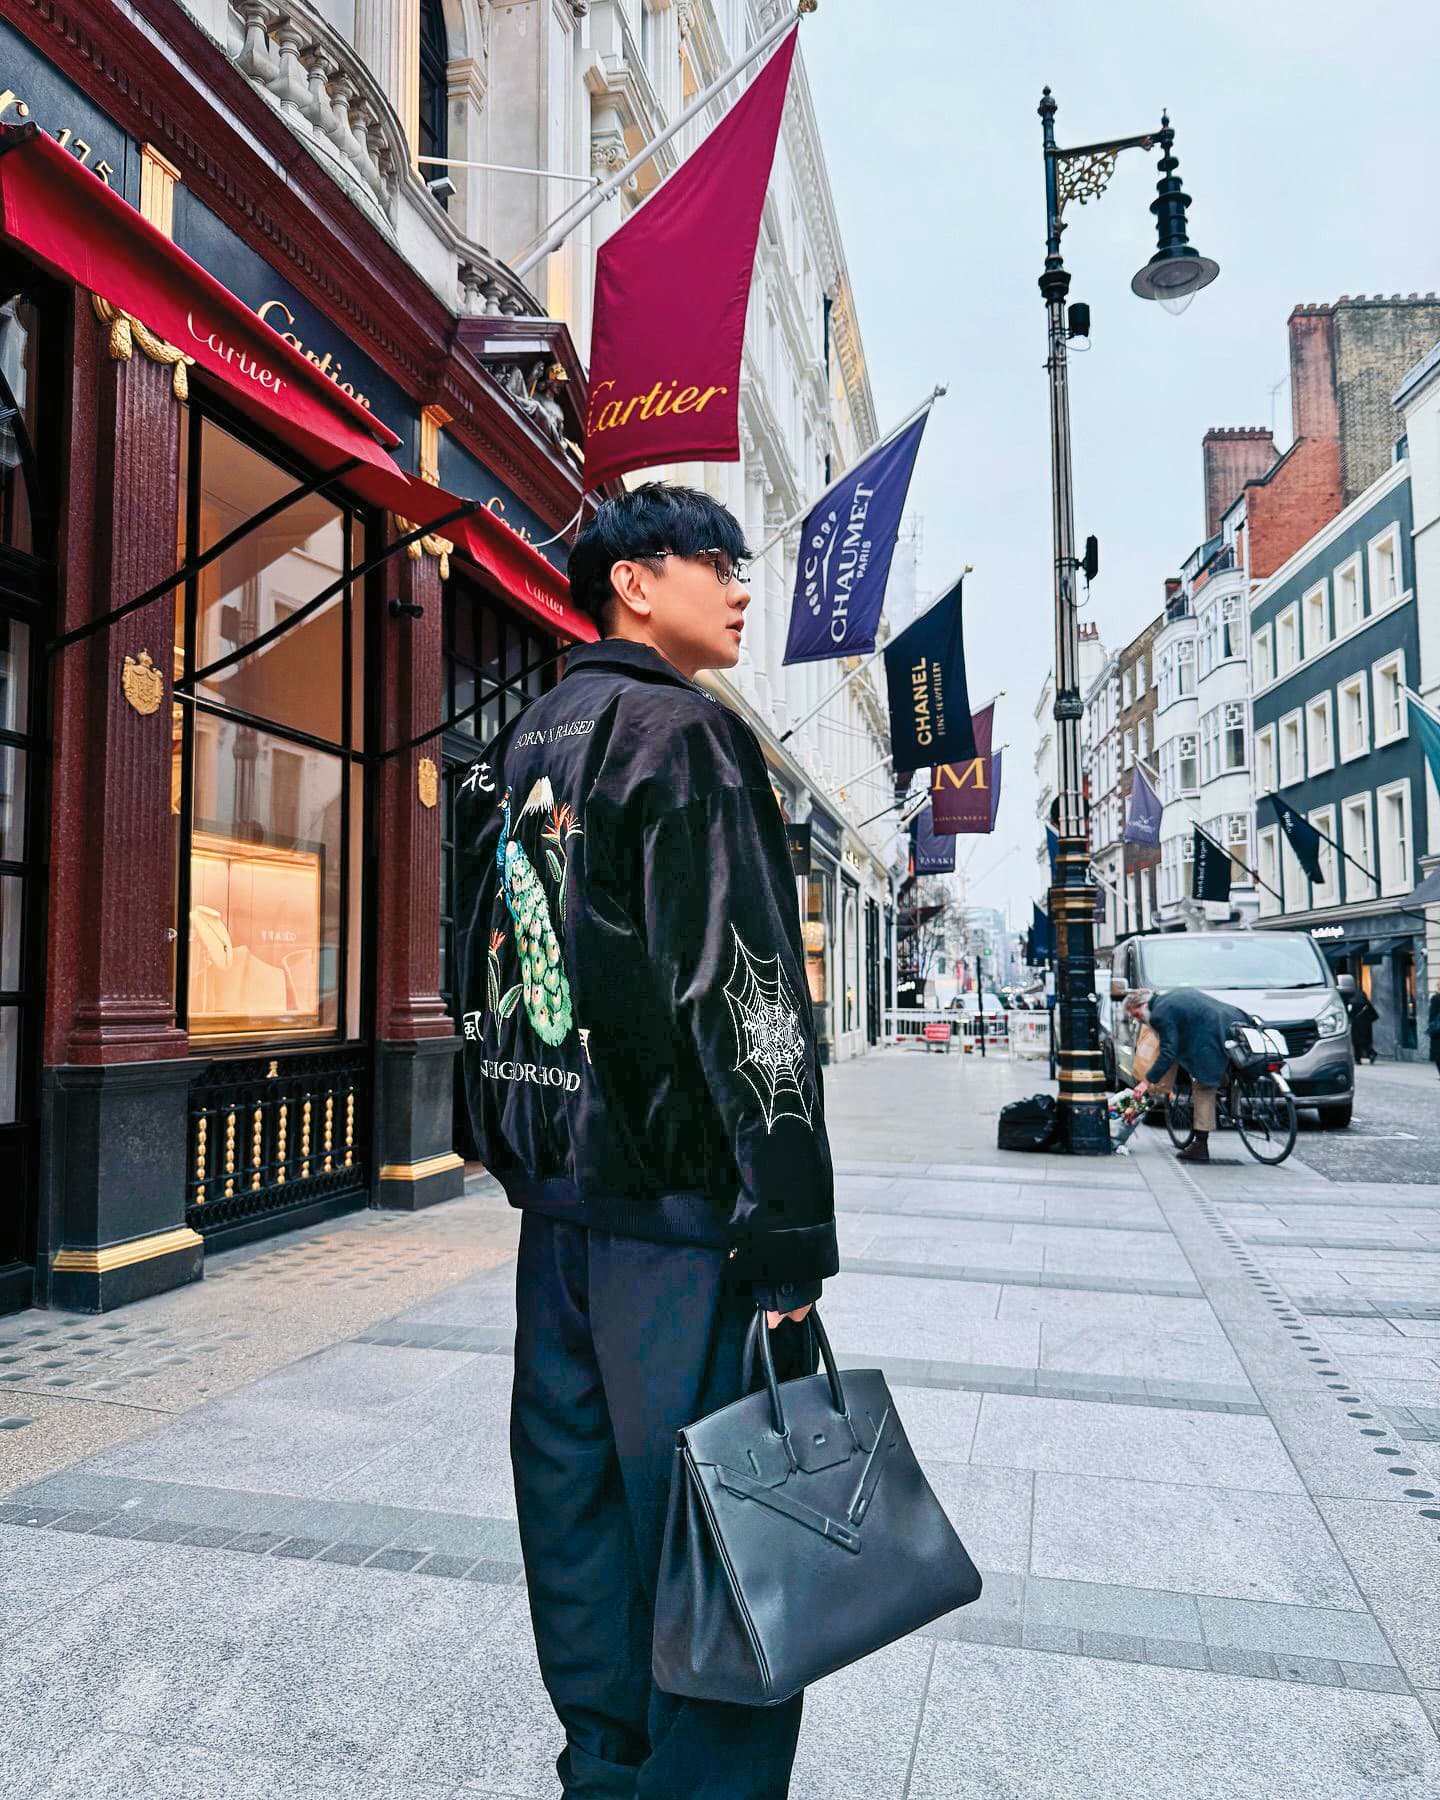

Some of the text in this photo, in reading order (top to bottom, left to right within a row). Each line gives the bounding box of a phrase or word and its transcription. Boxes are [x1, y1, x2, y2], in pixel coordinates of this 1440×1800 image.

[187, 312, 287, 395] Cartier
[586, 379, 728, 438] Cartier
[830, 481, 874, 643] CHAUMET
[856, 540, 872, 579] PARIS
[911, 656, 932, 746] CHANEL
[514, 730, 547, 749] ORN
[461, 761, 496, 792] 花
[932, 757, 989, 791] M
